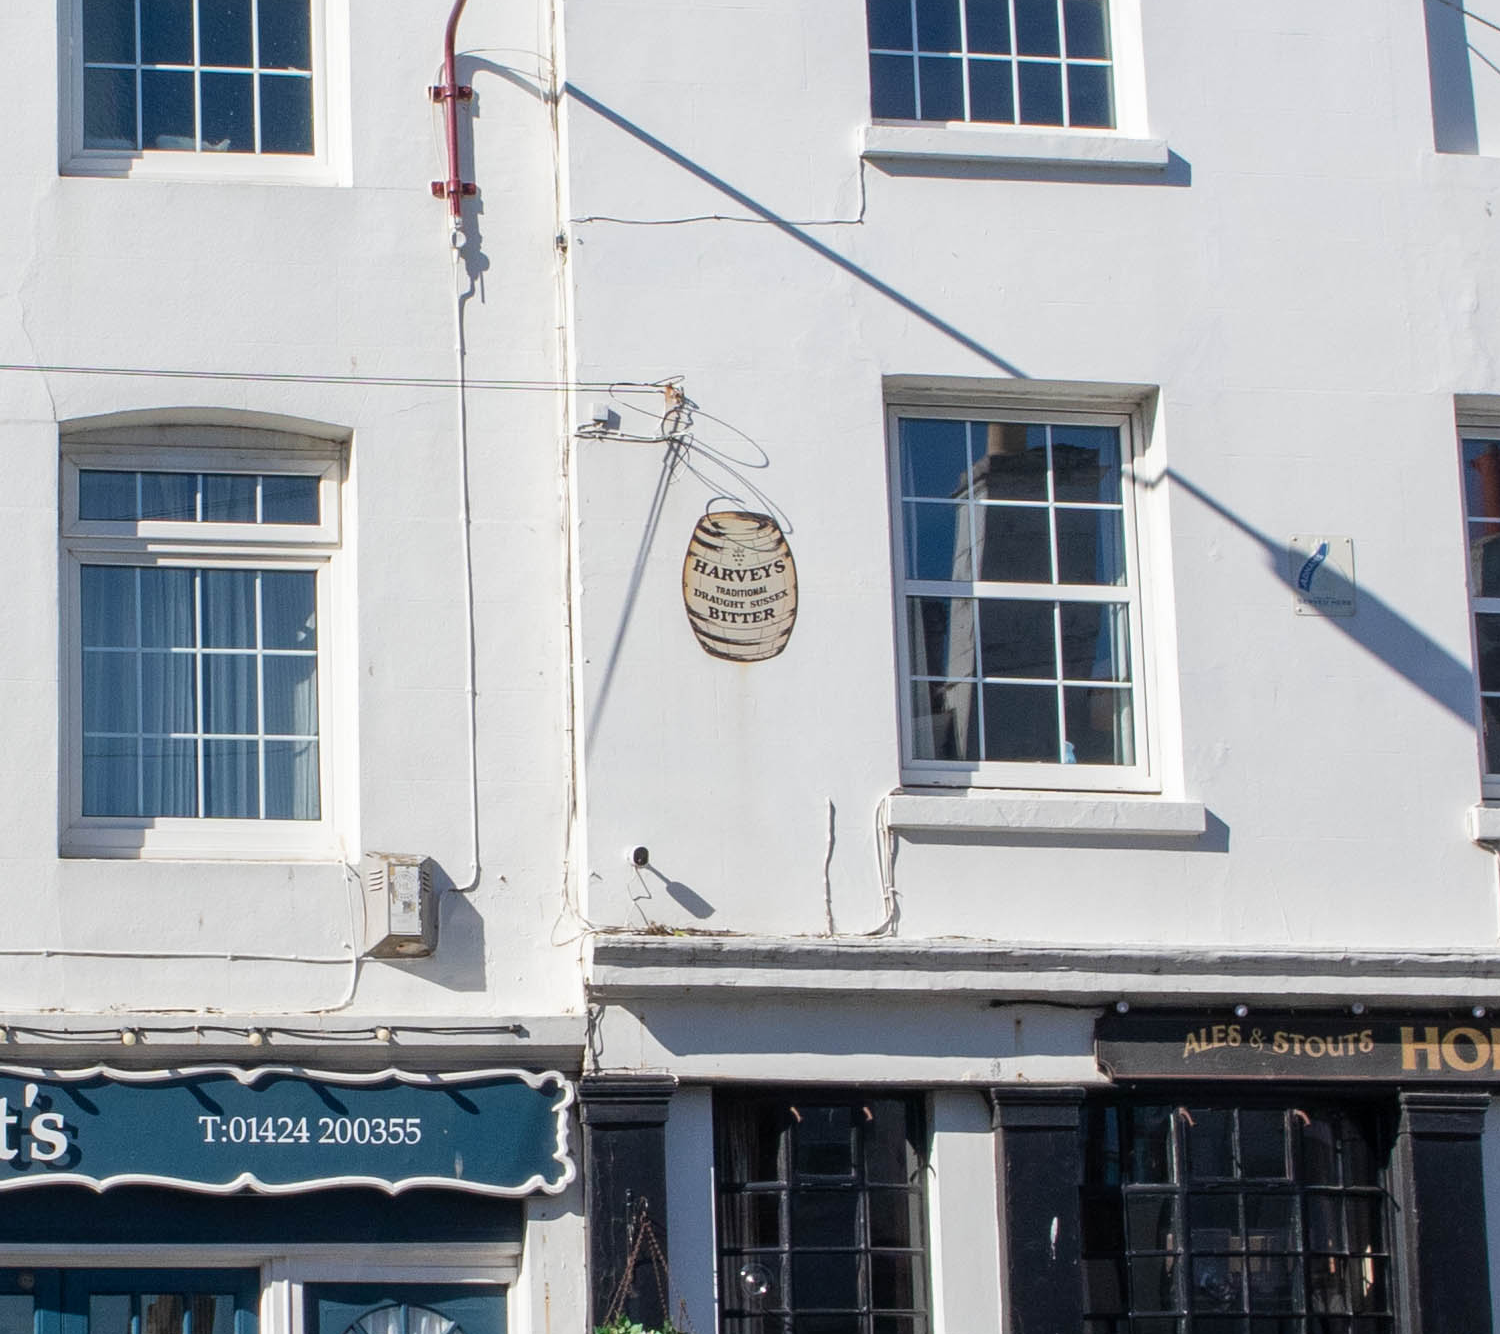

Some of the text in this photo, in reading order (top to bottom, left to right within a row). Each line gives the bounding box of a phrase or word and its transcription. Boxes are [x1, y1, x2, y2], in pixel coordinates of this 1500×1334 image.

[693, 559, 786, 583] HARVEYS
[693, 588, 789, 609] DRAUGHT SUSSEX
[716, 585, 768, 597] TRADITIONAL
[708, 606, 776, 624] BITTER
[1182, 1025, 1242, 1058] ALES
[1250, 1027, 1266, 1052] &
[1272, 1030, 1374, 1057] STOUTS
[199, 1115, 423, 1145] T:01424 200355
